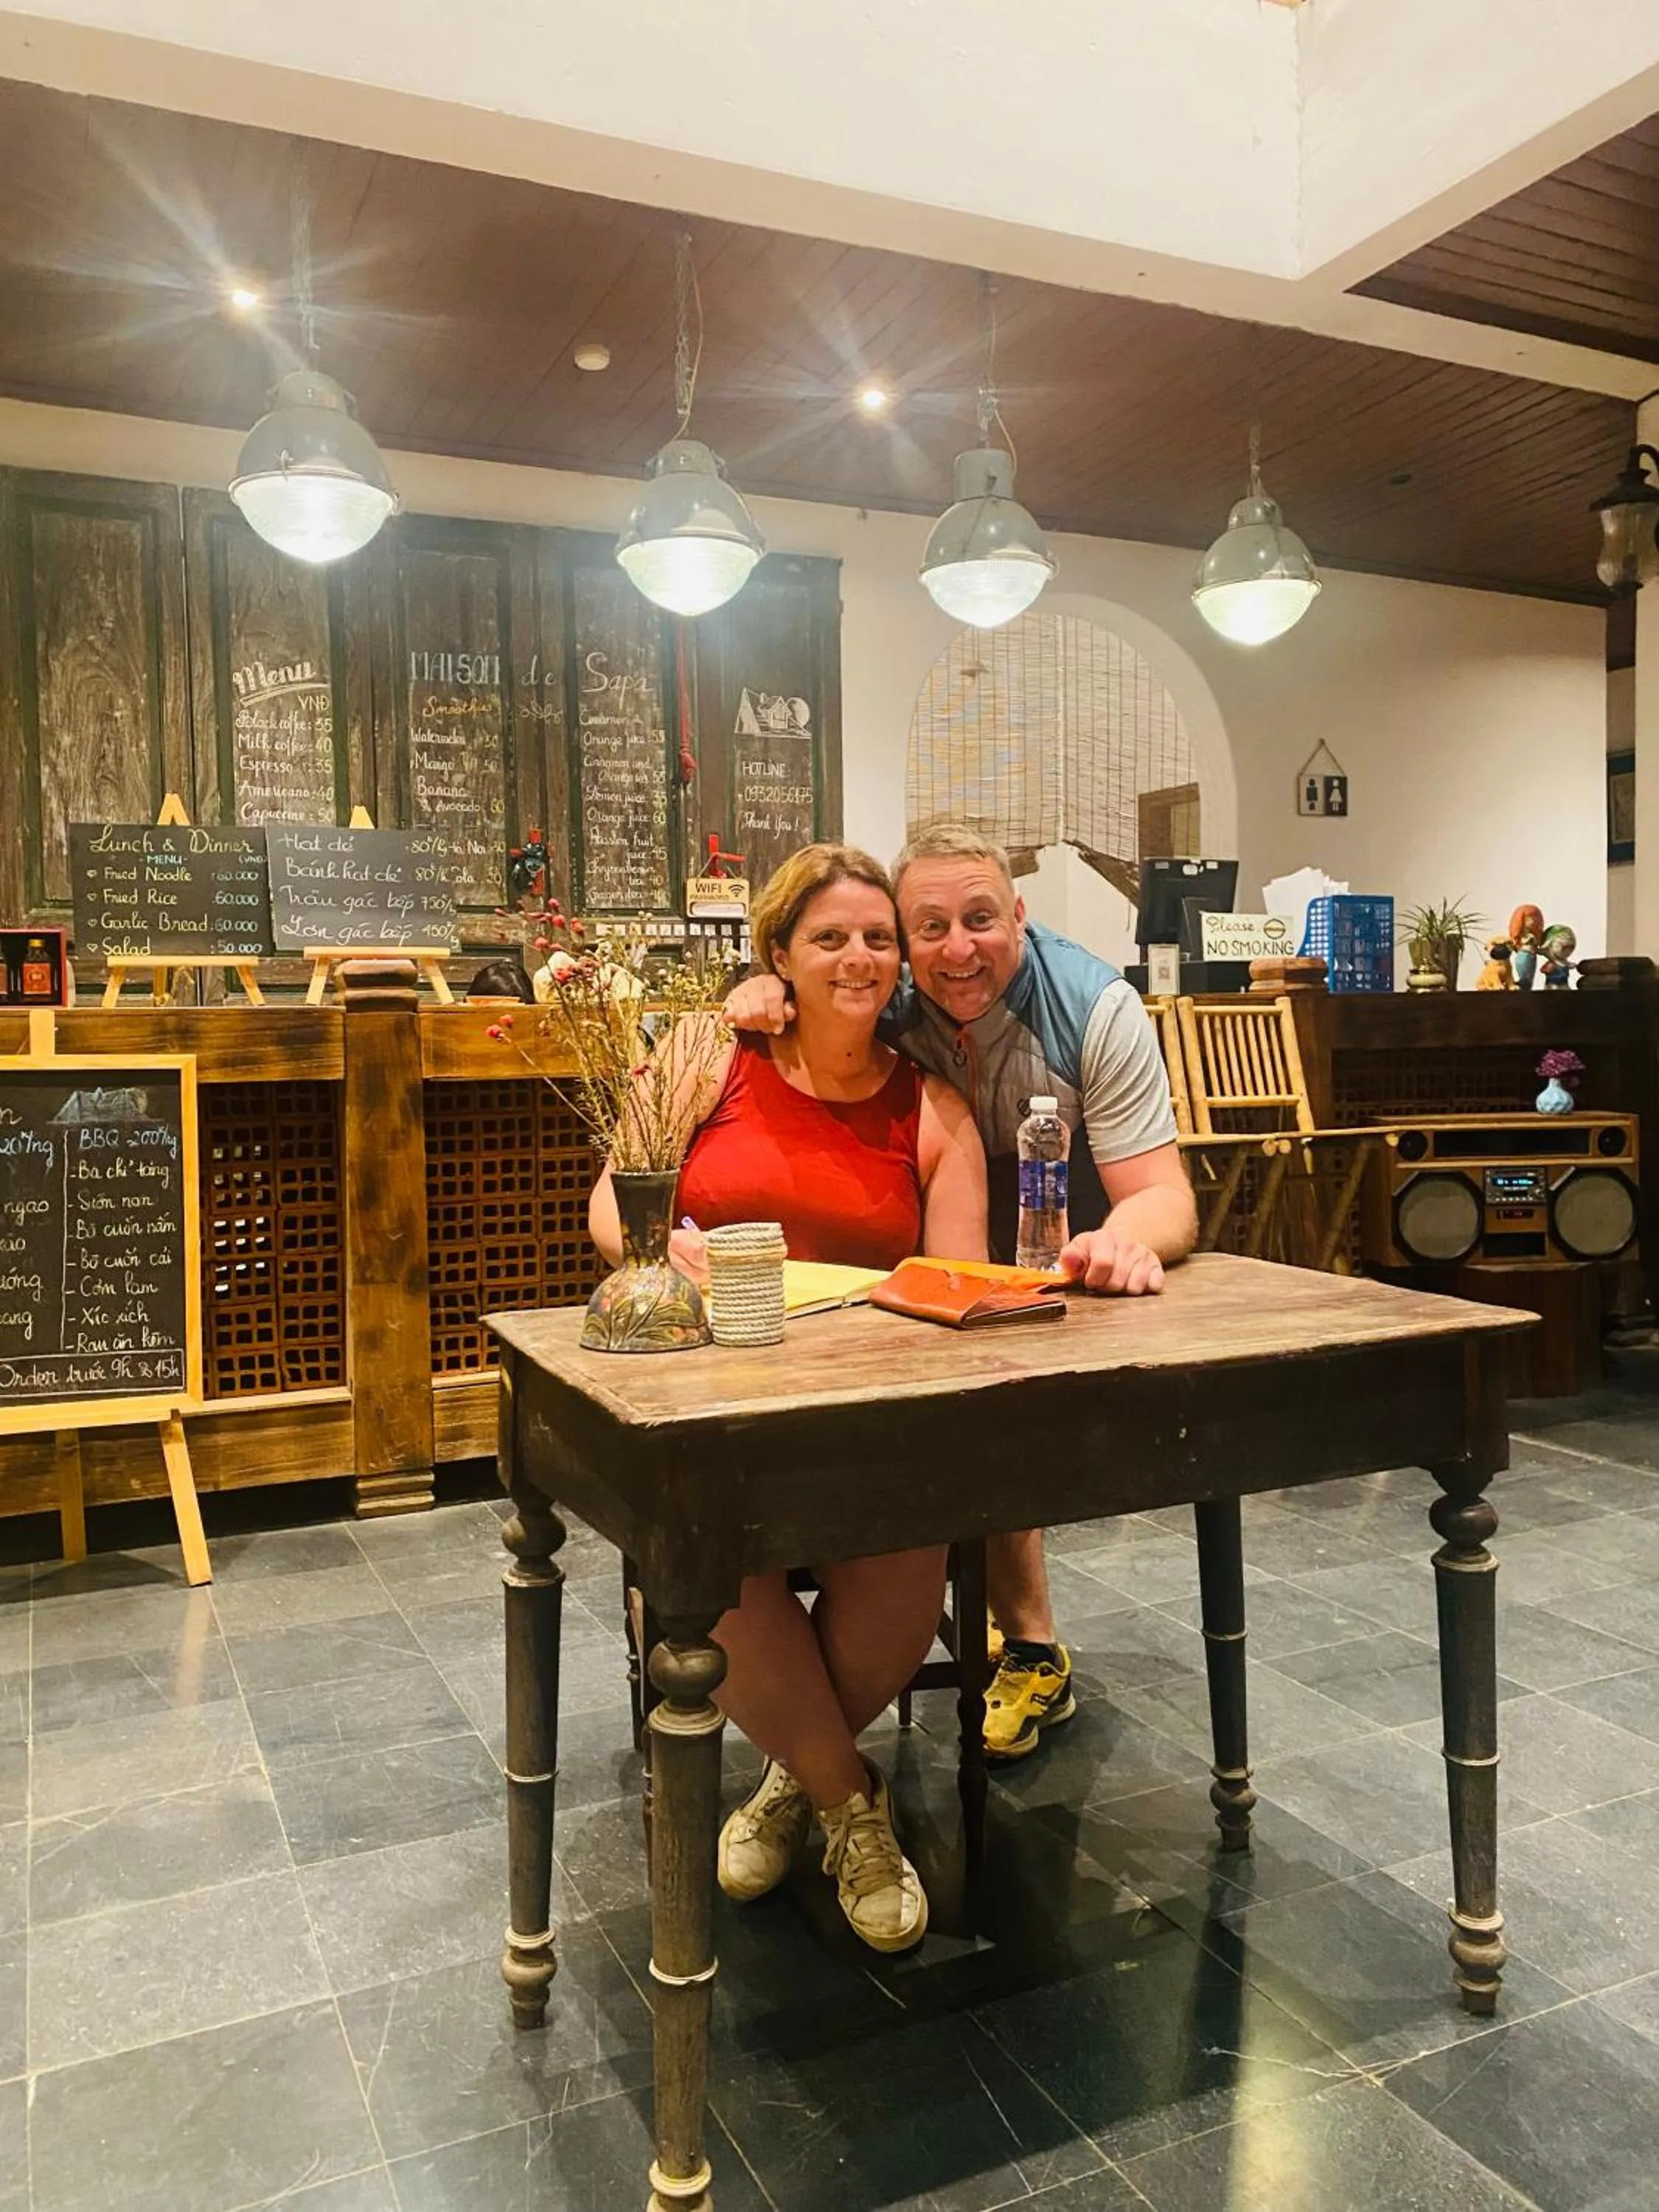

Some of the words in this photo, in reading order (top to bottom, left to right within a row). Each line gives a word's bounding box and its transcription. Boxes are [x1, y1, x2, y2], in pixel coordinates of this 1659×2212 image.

[232, 661, 317, 695] Menu
[411, 651, 500, 684] MAISON
[89, 824, 155, 853] Lunch
[162, 838, 177, 852] &
[187, 829, 254, 853] Dinner
[104, 867, 137, 880] Fried
[145, 867, 192, 881] Noodle
[103, 888, 139, 905] Fried
[147, 888, 178, 905] Rice
[695, 883, 721, 894] WIFI
[101, 911, 148, 931] Garlic
[159, 911, 208, 932] Bread
[1206, 916, 1256, 935] Please
[102, 935, 152, 956] Salad
[1207, 940, 1228, 956] NO
[1231, 939, 1295, 956] SMOKING
[79, 1128, 119, 1150] BBQ
[0, 1364, 59, 1388] Order
[111, 1355, 134, 1379] 9h
